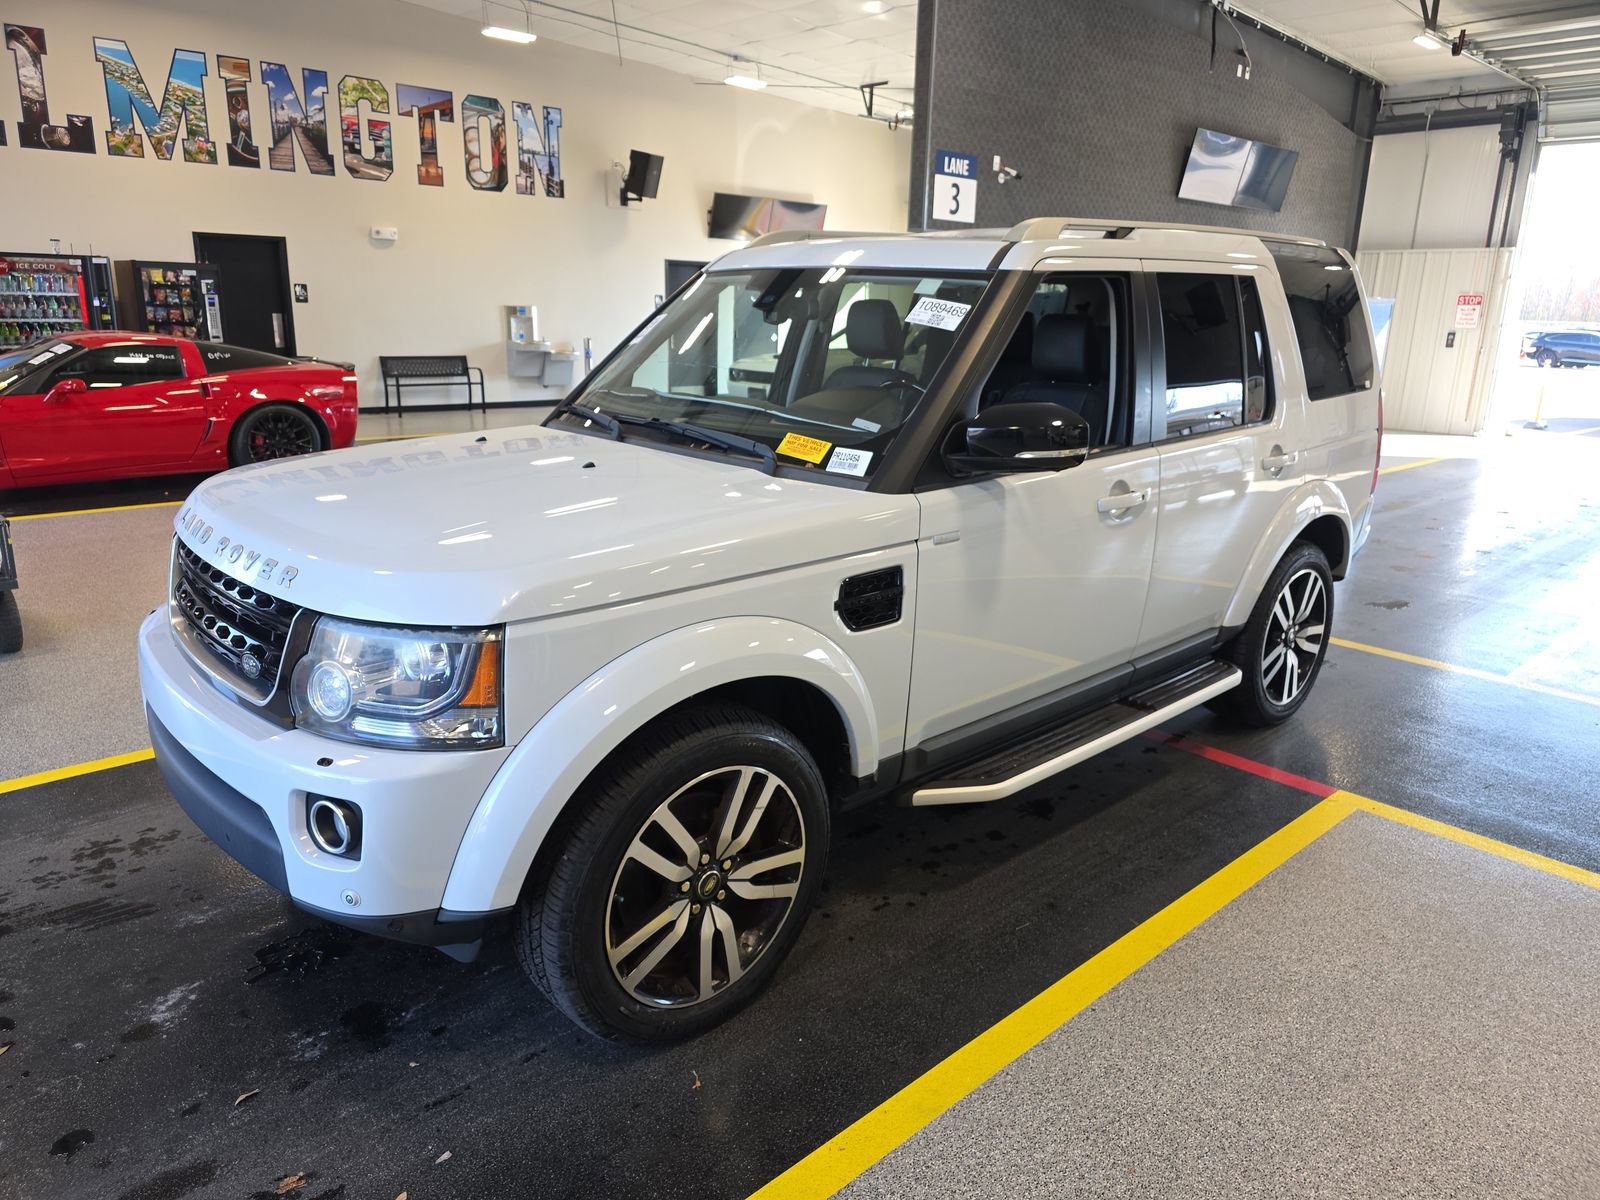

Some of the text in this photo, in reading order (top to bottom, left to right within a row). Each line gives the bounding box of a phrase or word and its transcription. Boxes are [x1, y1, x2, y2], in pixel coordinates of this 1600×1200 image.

[0, 22, 564, 198] LMINGTON
[944, 156, 970, 176] LANE
[949, 183, 960, 215] 3
[919, 300, 967, 317] 1089469
[1458, 296, 1482, 305] STOP
[788, 434, 827, 448] THIS VEHICLE
[182, 507, 299, 589] LAND ROVER
